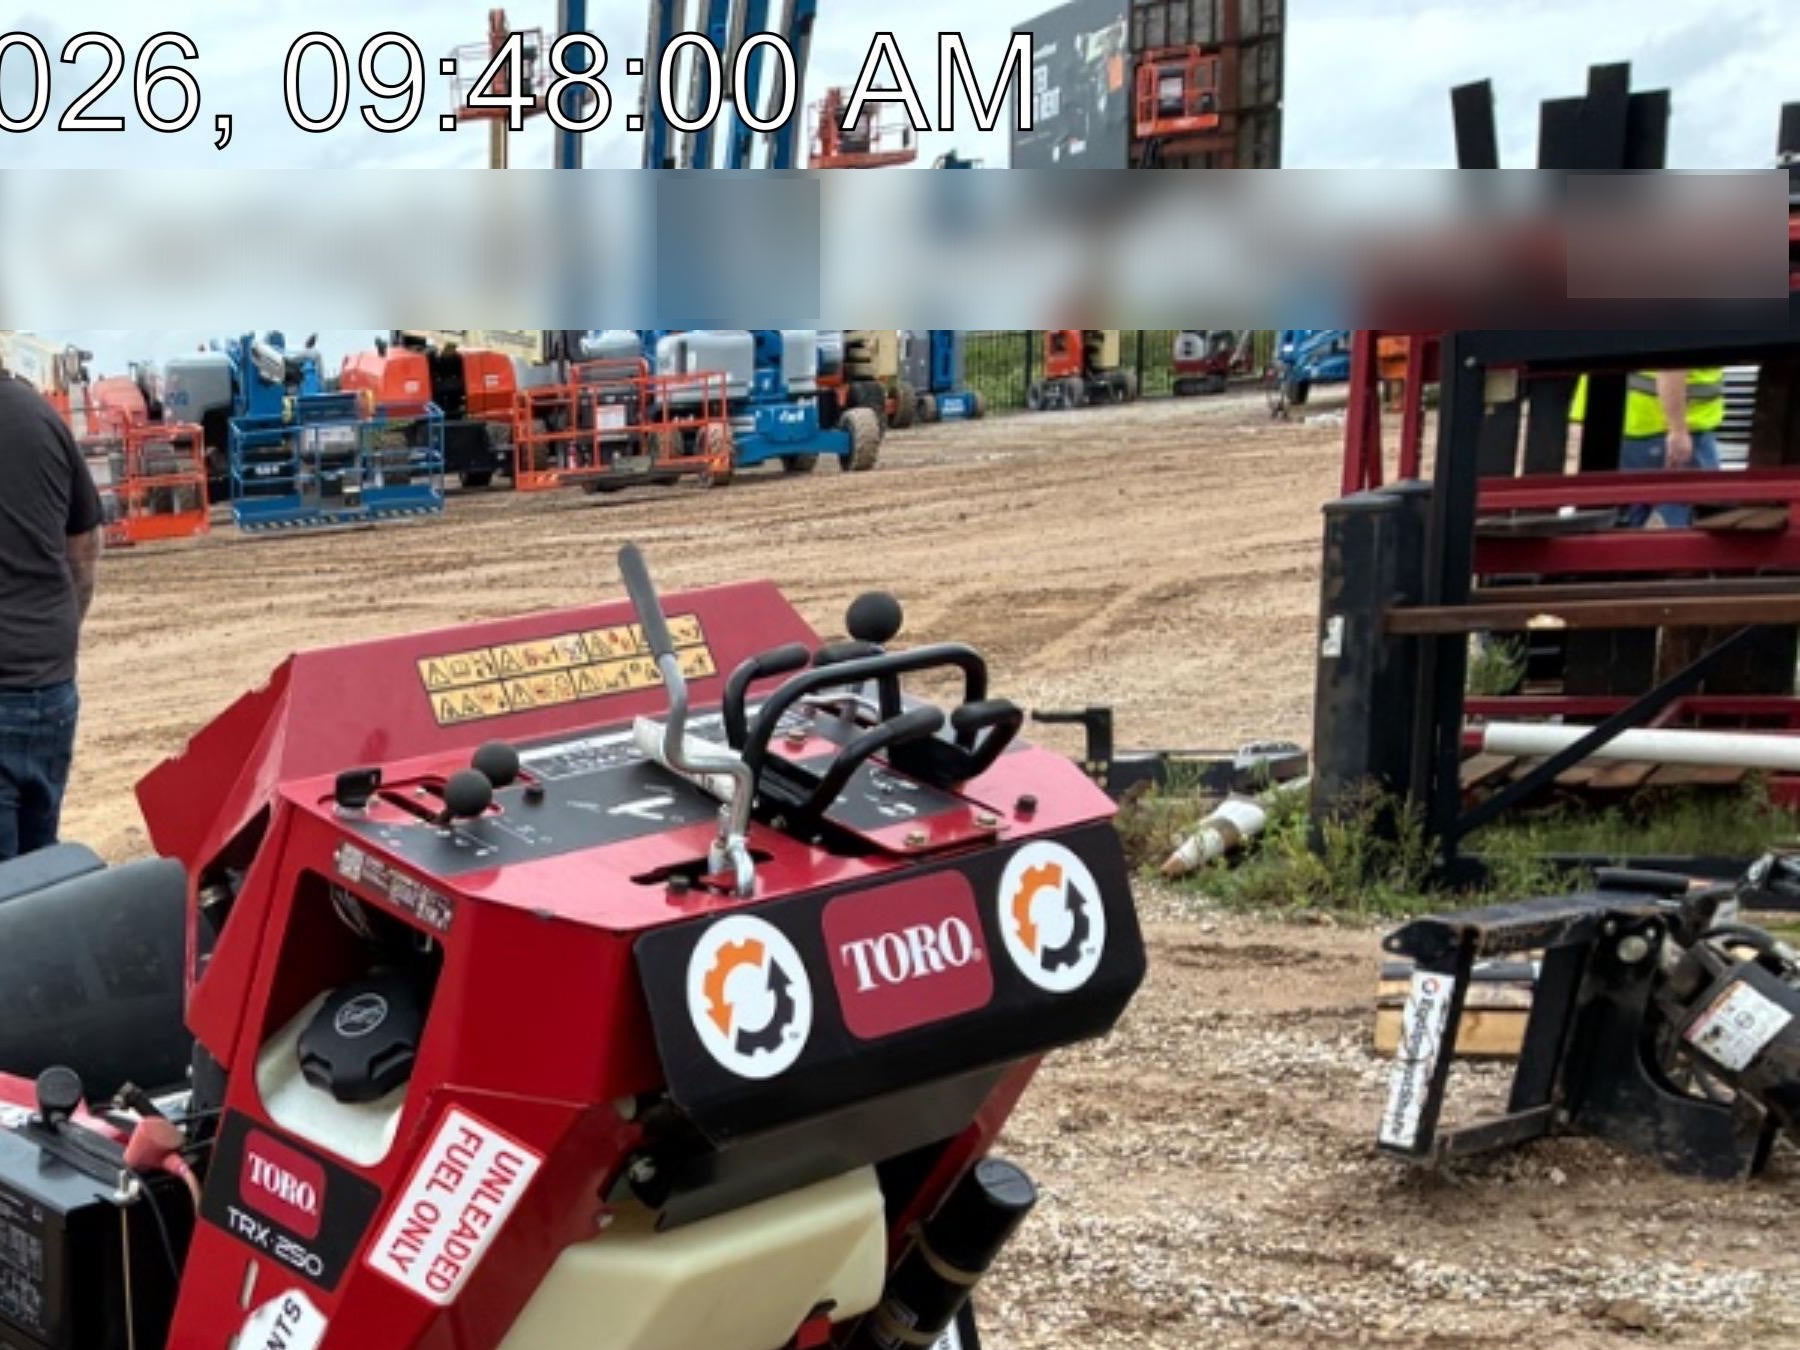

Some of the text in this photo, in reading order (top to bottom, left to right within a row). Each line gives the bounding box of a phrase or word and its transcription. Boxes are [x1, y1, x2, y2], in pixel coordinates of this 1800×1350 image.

[840, 916, 974, 992] TORO
[248, 1151, 317, 1212] TORO
[386, 1124, 485, 1275] FUEL ONLY
[425, 1149, 526, 1294] UNLEADED
